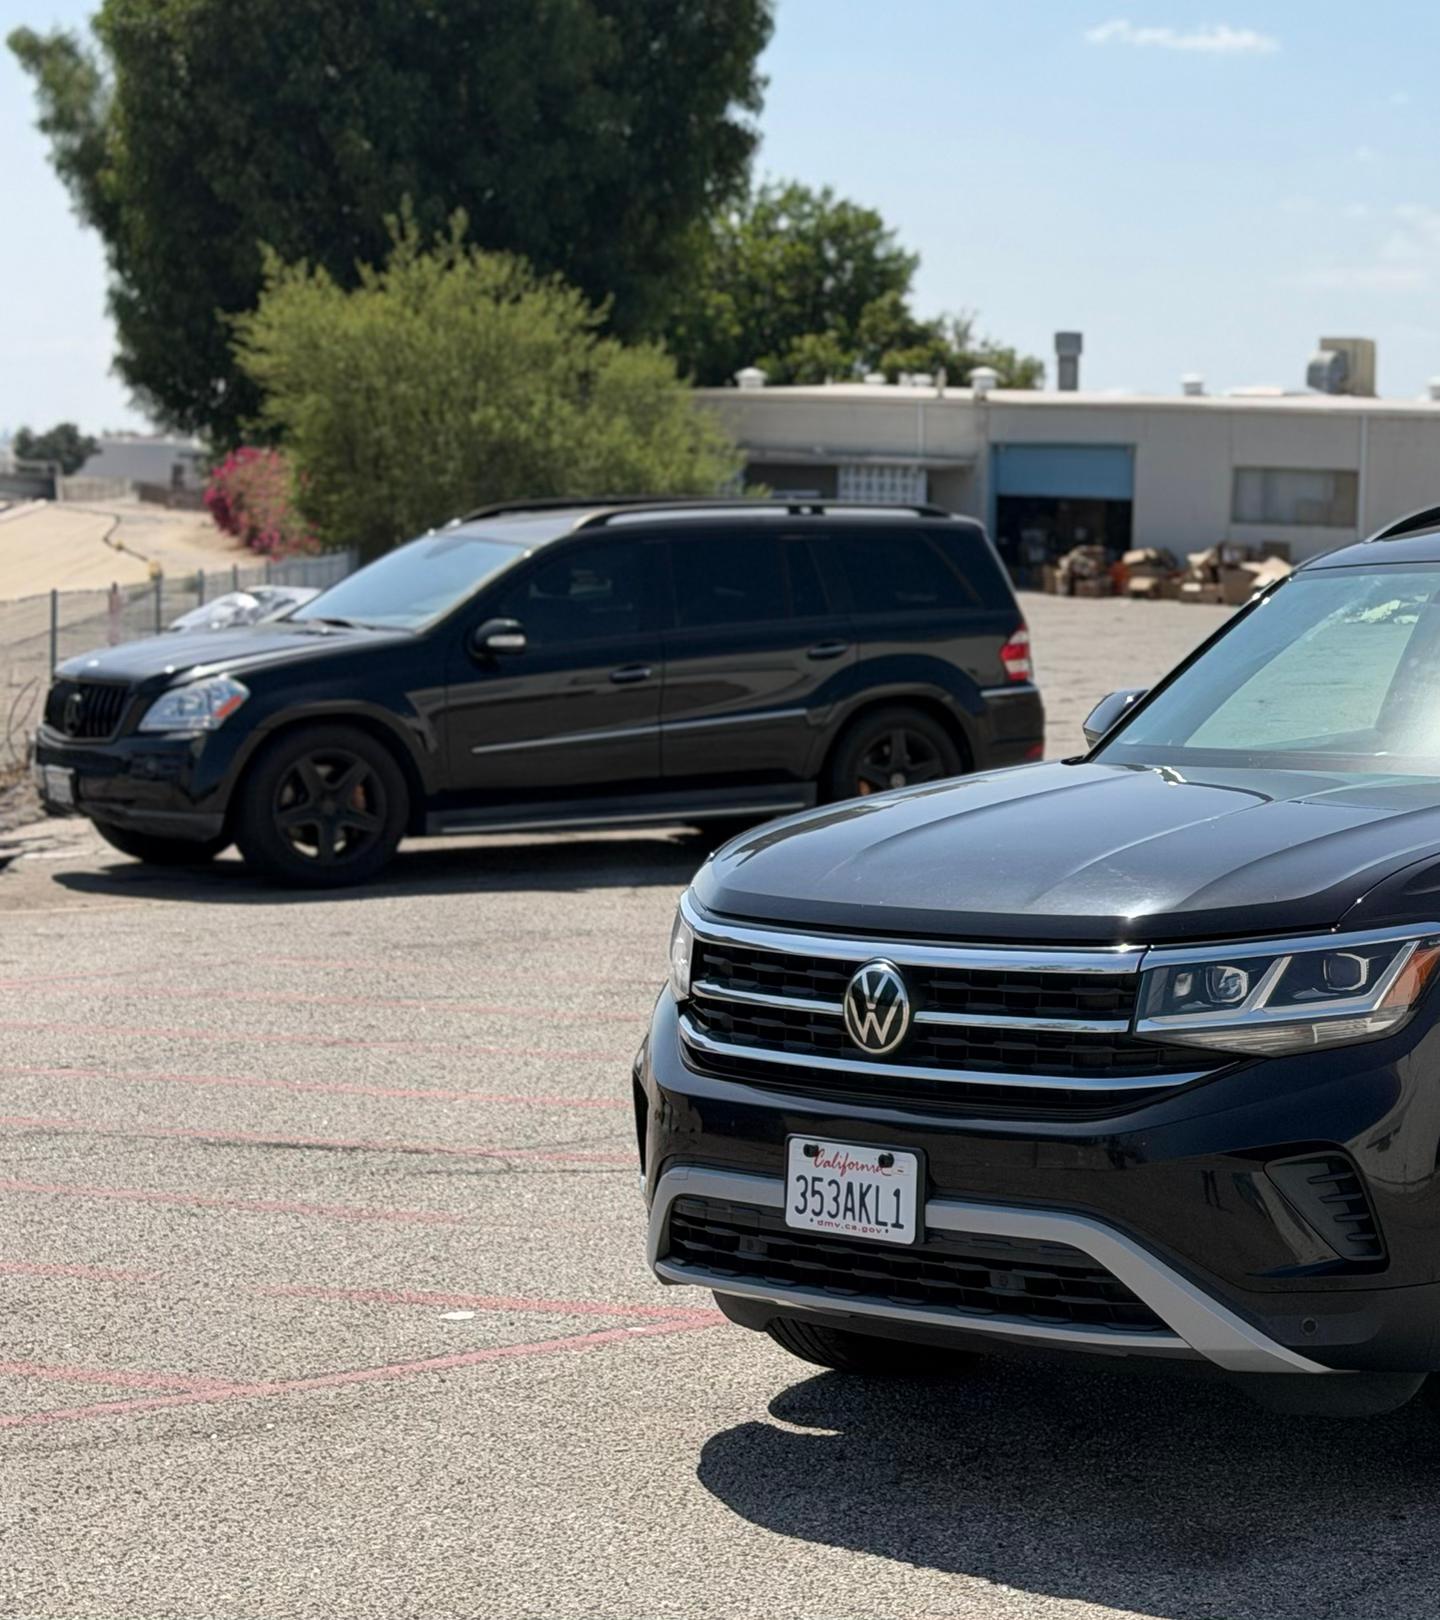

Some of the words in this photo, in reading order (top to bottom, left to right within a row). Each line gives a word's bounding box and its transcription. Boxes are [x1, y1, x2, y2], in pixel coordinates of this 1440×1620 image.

[847, 968, 903, 1047] VW
[813, 1148, 887, 1177] California
[794, 1174, 904, 1230] 353AKL1
[816, 1219, 883, 1234] dmv.ca.gov
